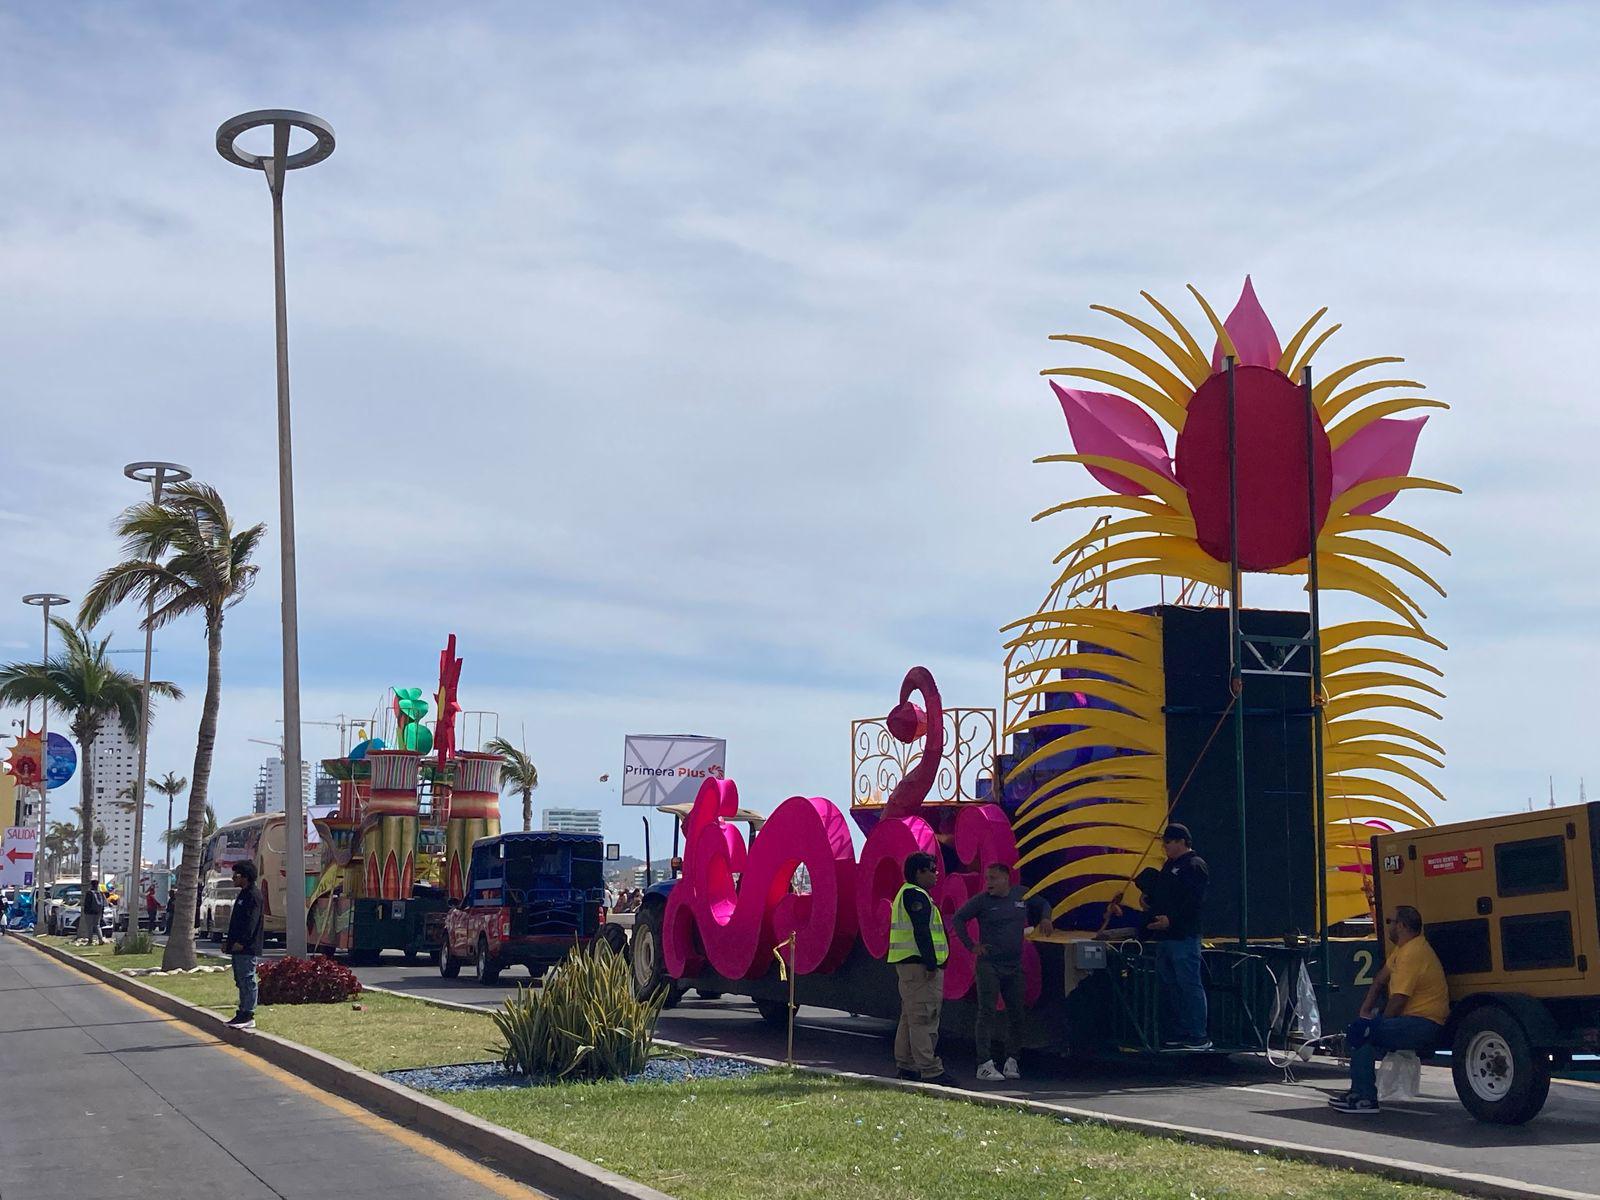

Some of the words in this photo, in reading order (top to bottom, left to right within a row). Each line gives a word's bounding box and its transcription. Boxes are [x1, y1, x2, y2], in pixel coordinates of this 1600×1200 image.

[626, 765, 674, 777] Primera
[678, 767, 705, 778] Plus
[7, 828, 35, 840] SALIDA
[1385, 855, 1400, 871] CAT
[1353, 950, 1374, 986] 2
